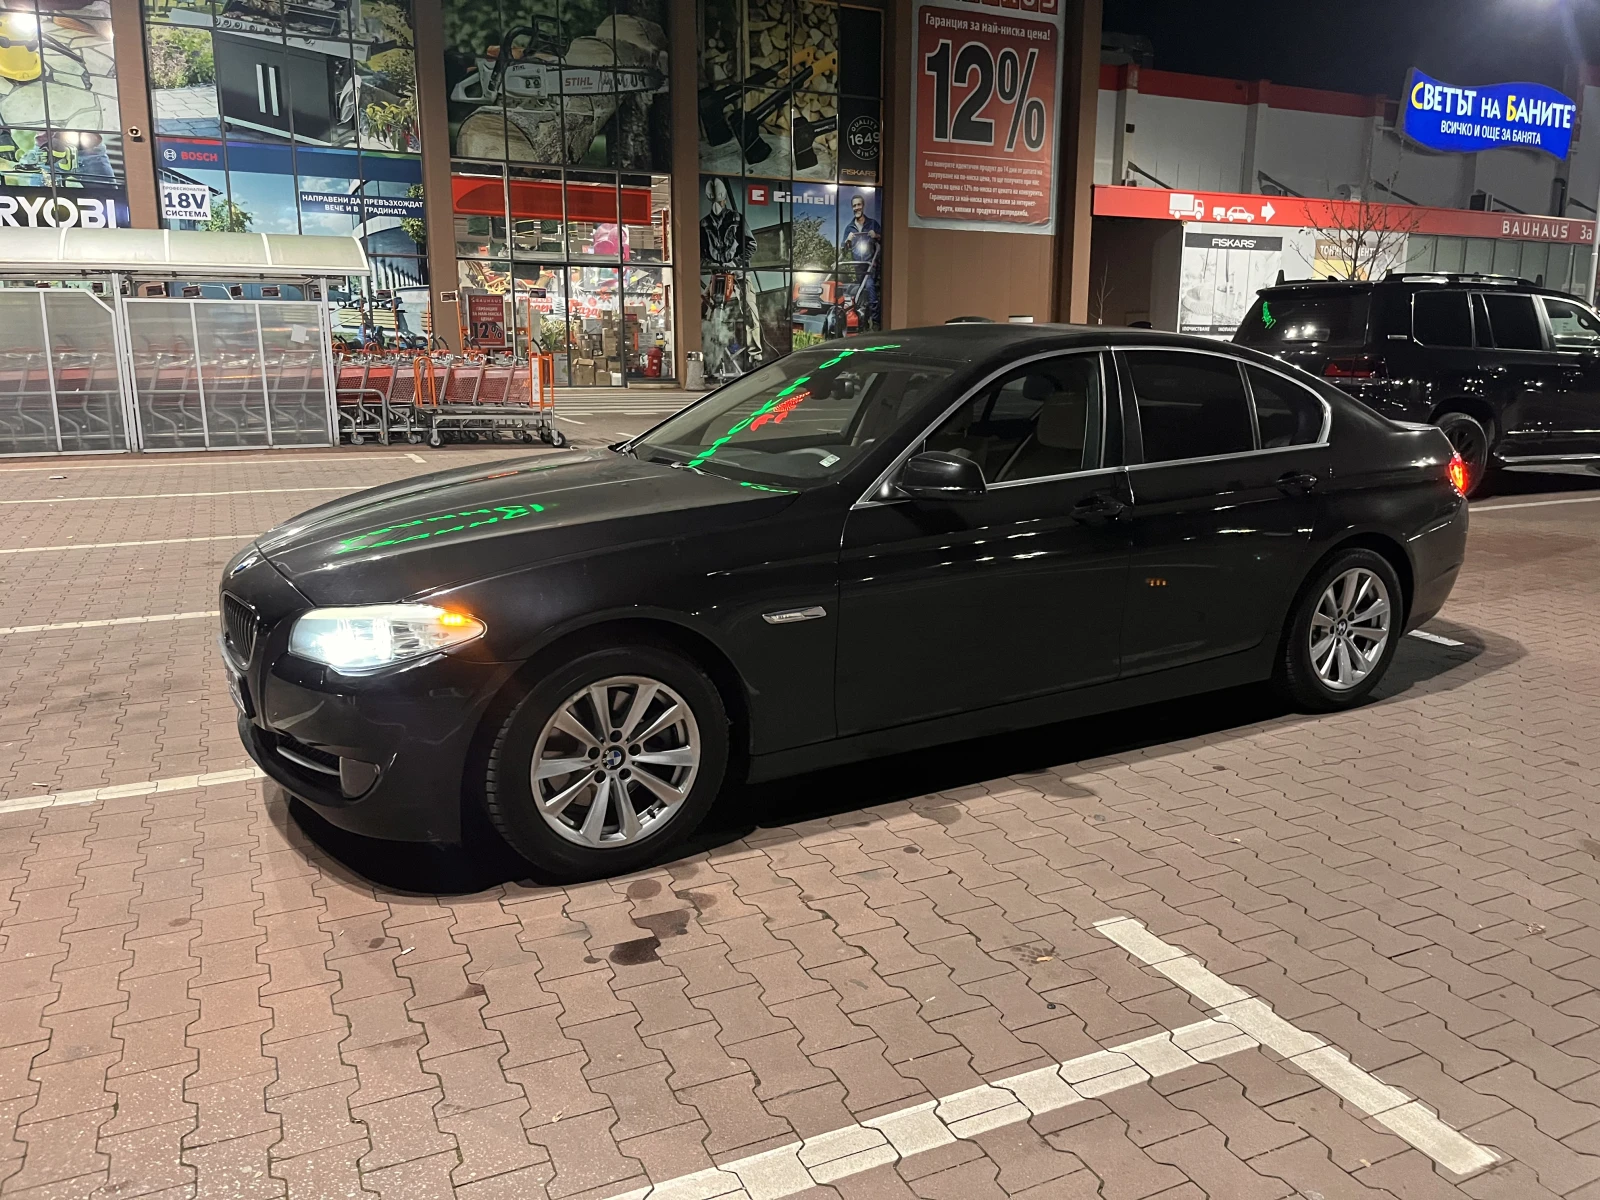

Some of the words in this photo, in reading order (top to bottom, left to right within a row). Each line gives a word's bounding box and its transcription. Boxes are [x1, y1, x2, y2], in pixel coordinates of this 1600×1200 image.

[925, 13, 968, 30] Гаранция
[970, 21, 980, 31] за
[982, 22, 1025, 37] най-ниска
[1027, 29, 1051, 41] цена!
[564, 76, 593, 87] STIHL
[925, 38, 1046, 152] 12%
[1411, 82, 1477, 116] СВЕТЪТ
[1481, 97, 1501, 119] НА
[851, 119, 877, 132] QUALITY
[1441, 120, 1473, 136] ВСИЧКО
[1474, 126, 1481, 136] И
[1482, 126, 1500, 141] ОЩЕ
[1501, 128, 1511, 141] ЗА
[1513, 129, 1541, 145] БАНЯТА
[849, 132, 880, 146] 1649
[181, 151, 218, 162] BOSCH
[857, 148, 878, 157] SINCE
[840, 168, 876, 177] FISKARS
[164, 192, 206, 209] 18V
[302, 195, 348, 204] НАПРАВЕНИ
[350, 197, 361, 205] ДА
[364, 198, 423, 208] ПРЕВЪЗХОЖДАТ
[773, 190, 835, 205] Einhell
[166, 209, 208, 218] СИСТЕМА
[324, 204, 344, 212] ВЕЧЕ
[364, 206, 407, 215] ГРАДИНАТА
[1502, 220, 1568, 239] BAUHAUS
[472, 322, 503, 339] 12%
